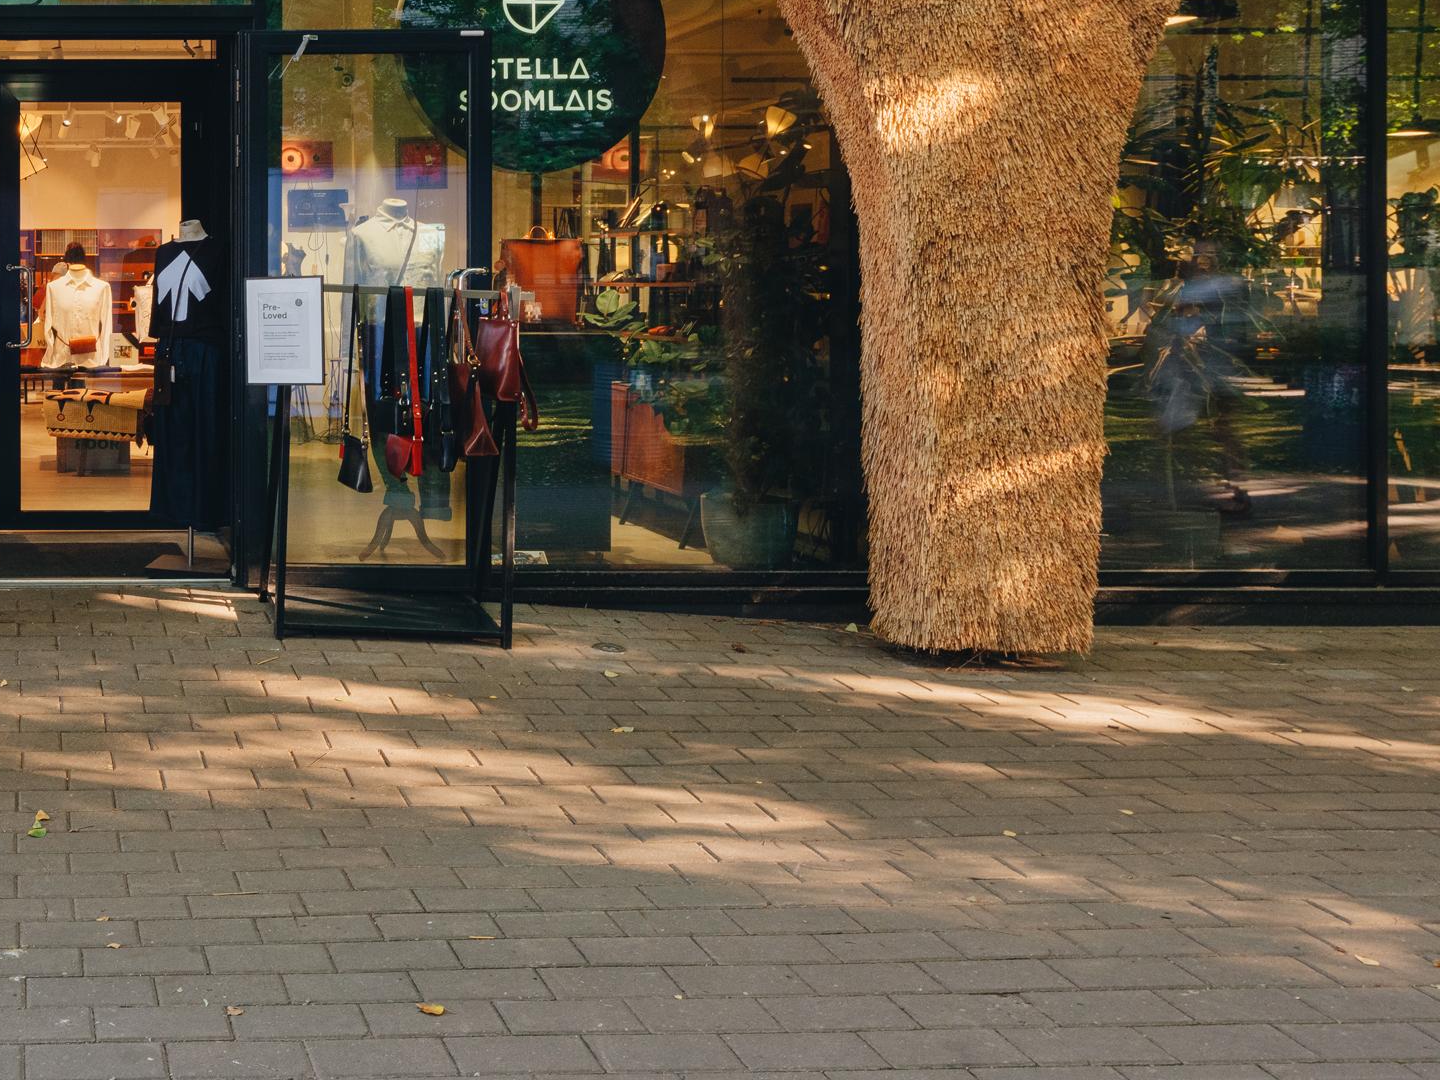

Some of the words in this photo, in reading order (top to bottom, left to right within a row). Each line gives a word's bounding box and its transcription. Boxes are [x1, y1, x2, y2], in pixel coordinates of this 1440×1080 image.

[491, 58, 590, 80] TELLA
[459, 88, 613, 112] SOMLAIS
[262, 303, 281, 311] Pre-
[262, 312, 288, 320] Loved
